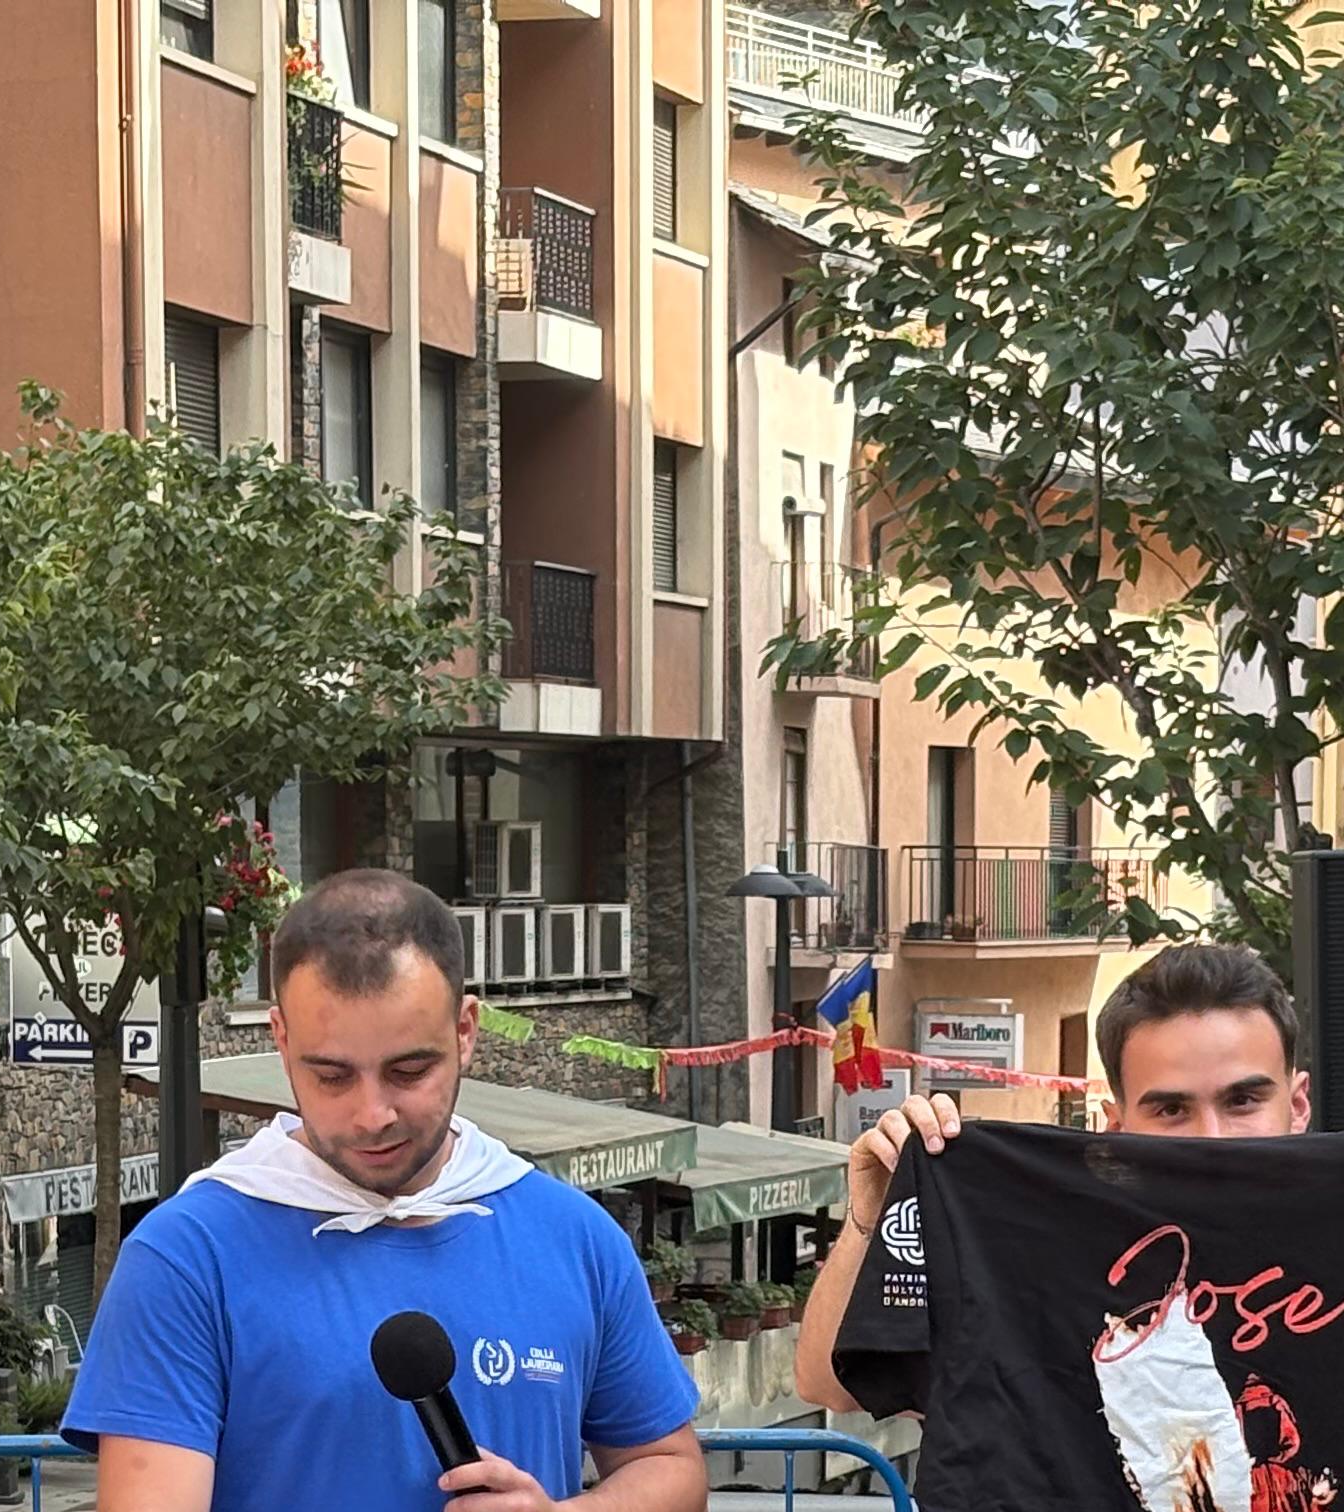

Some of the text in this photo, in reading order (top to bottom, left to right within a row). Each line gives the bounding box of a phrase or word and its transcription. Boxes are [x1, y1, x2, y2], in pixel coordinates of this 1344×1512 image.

[14, 1022, 153, 1059] PARKI P
[951, 1022, 1011, 1041] Marlboro
[569, 1140, 665, 1185] RESTAURANT
[45, 1162, 159, 1214] RESTRANT
[749, 1177, 811, 1214] PIZZERIA
[883, 1284, 928, 1295] CULTU
